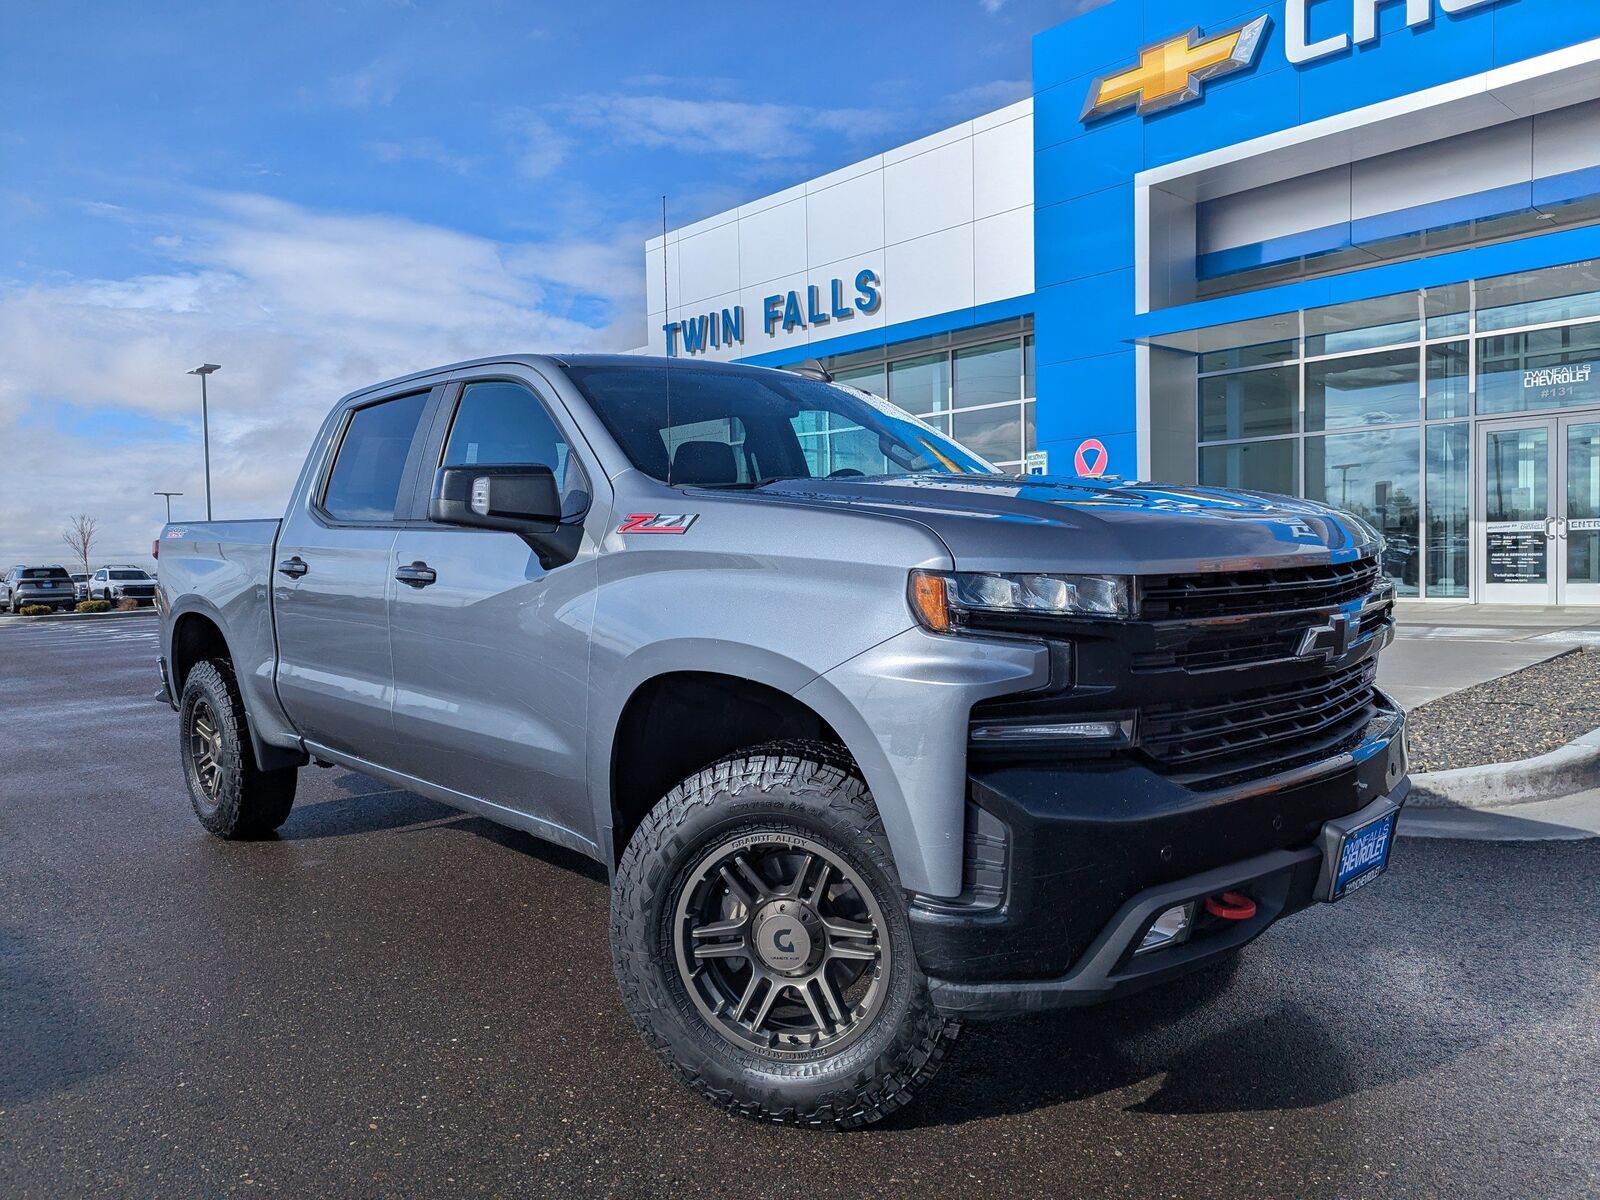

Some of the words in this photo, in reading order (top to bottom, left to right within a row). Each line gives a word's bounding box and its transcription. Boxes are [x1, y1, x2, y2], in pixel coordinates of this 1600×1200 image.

[663, 306, 744, 357] TWIN
[764, 269, 882, 337] FALLS
[1523, 370, 1591, 388] CHEVROLET
[1541, 386, 1574, 398] #131
[617, 513, 700, 535] Z71
[731, 834, 772, 849] GRANITE
[775, 834, 808, 847] ALLOY
